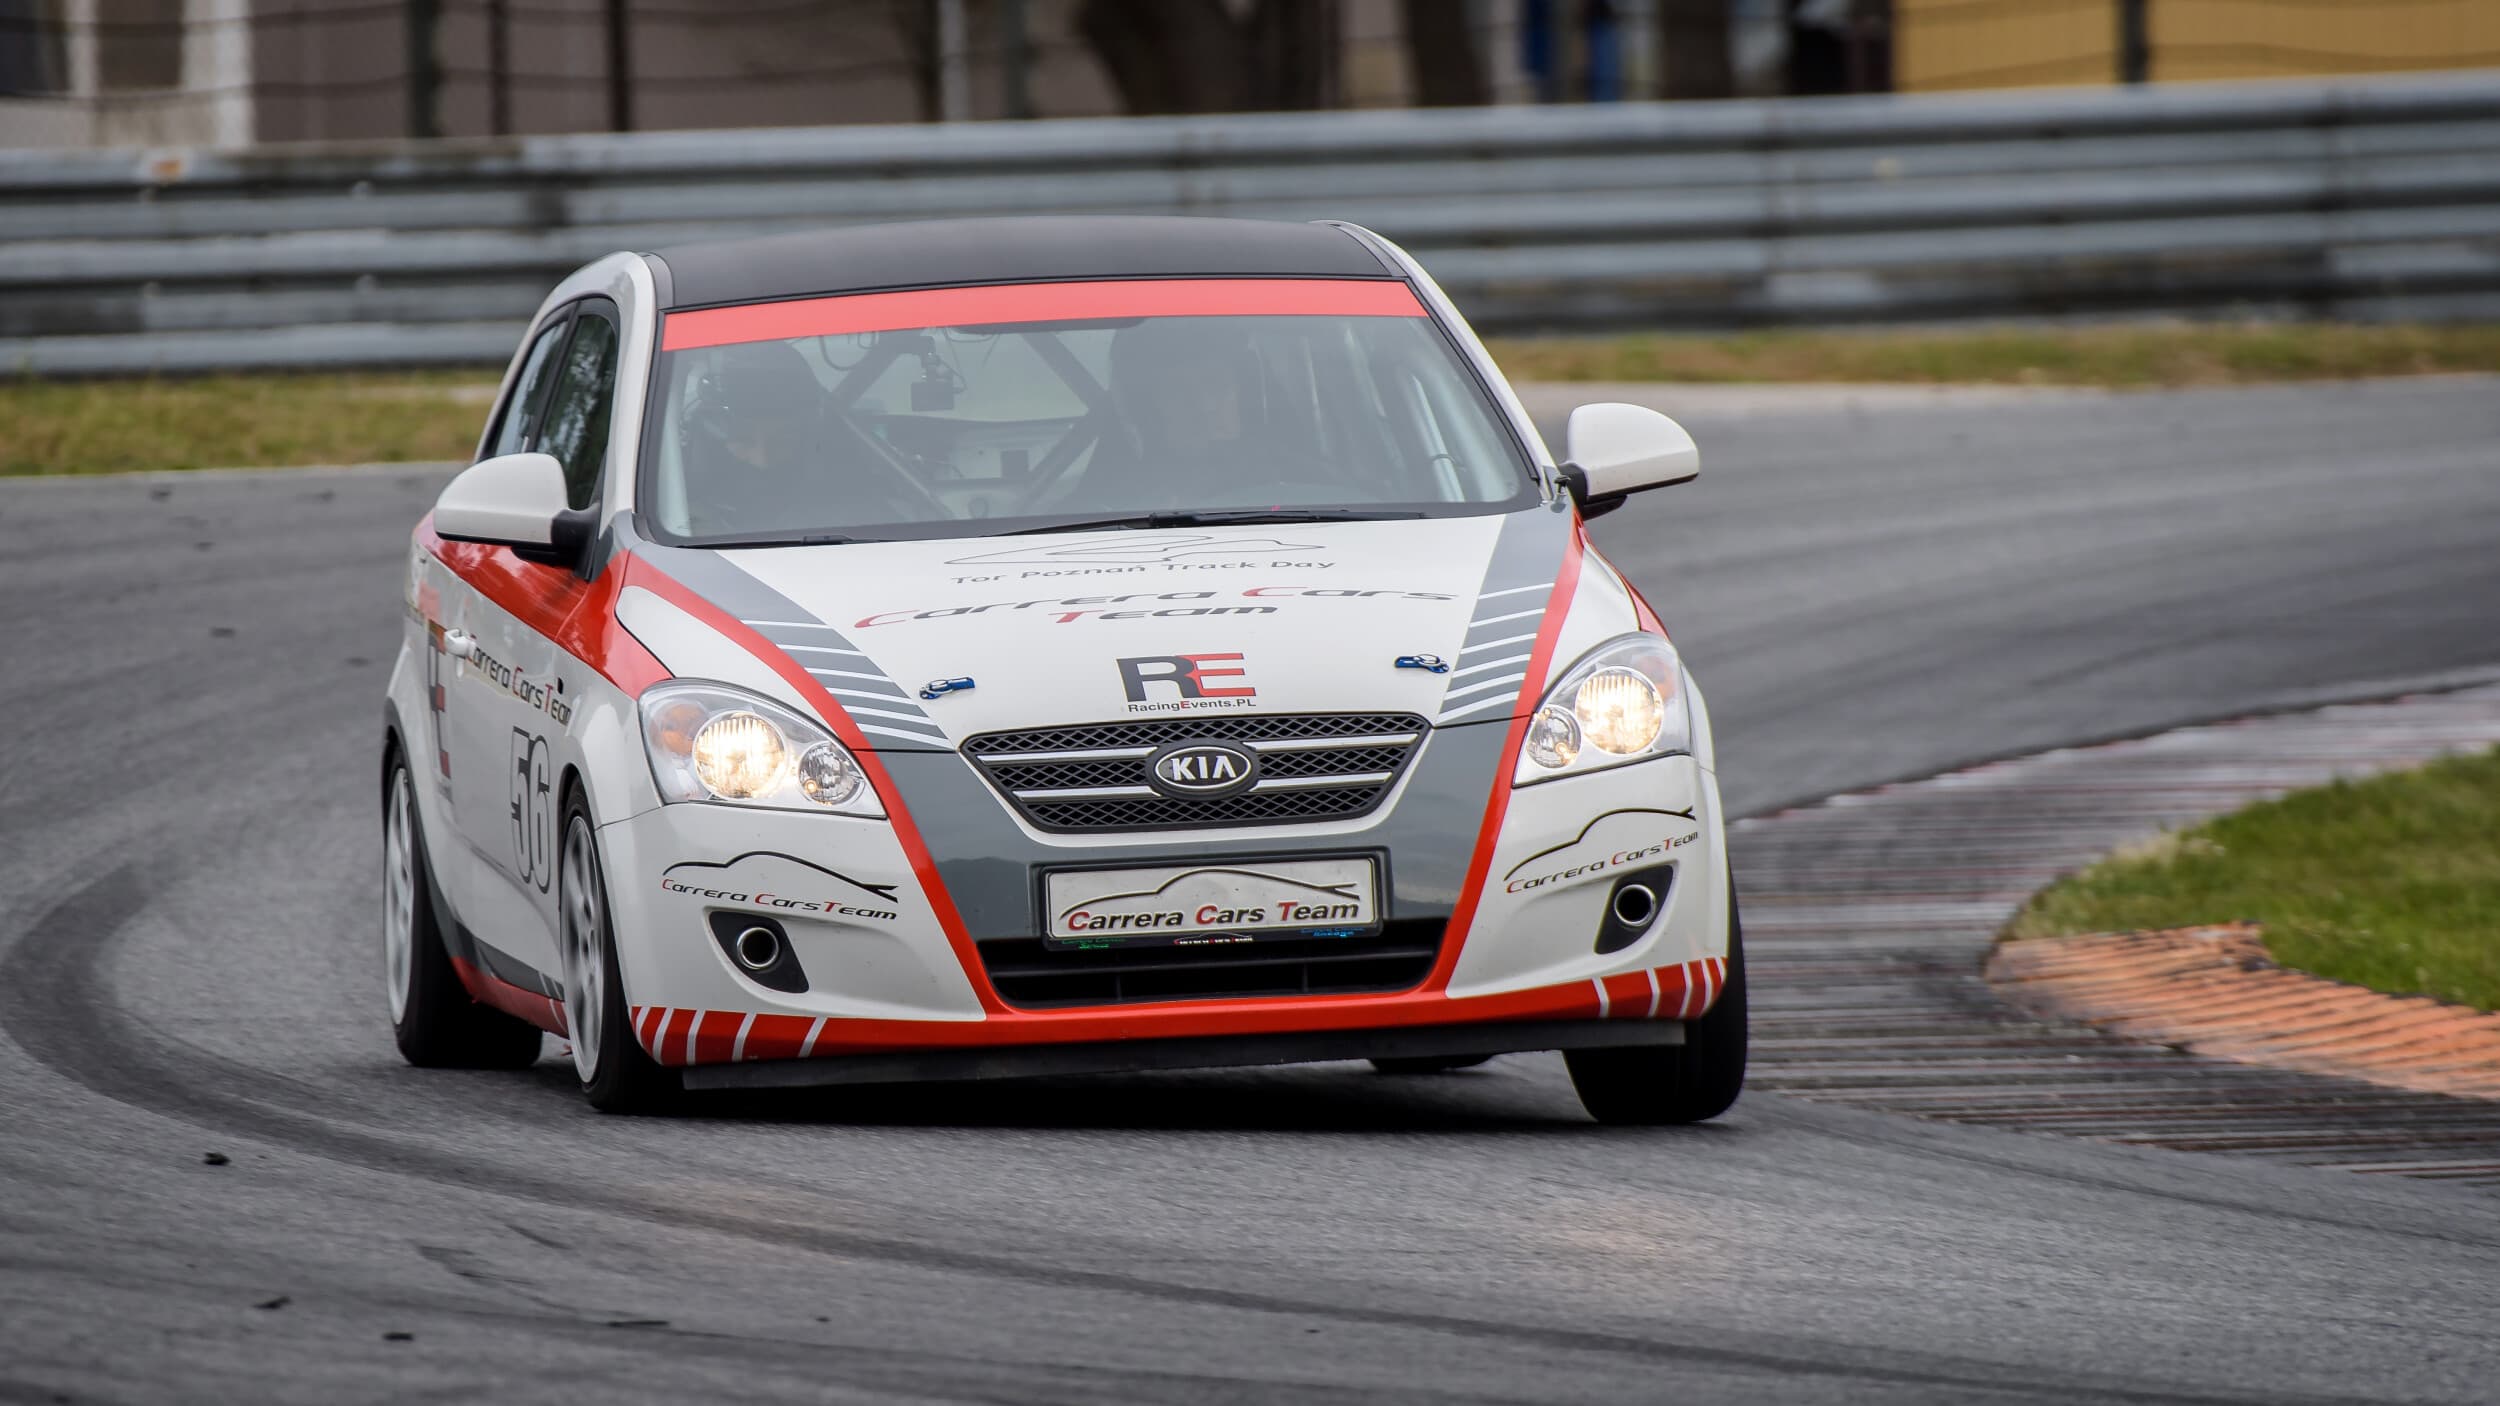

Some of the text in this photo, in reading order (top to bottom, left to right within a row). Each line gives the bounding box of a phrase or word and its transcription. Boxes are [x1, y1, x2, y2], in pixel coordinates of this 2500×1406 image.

[951, 560, 1336, 584] Tor Poznań Track Day
[854, 586, 1459, 629] Carrera Cars
[1048, 605, 1278, 624] Team
[1116, 652, 1257, 703] RE
[1127, 698, 1257, 713] RacingEvents.PL
[1169, 755, 1237, 783] KIA
[510, 726, 551, 895] 56
[661, 878, 749, 903] Carrera
[1505, 861, 1604, 894] Carrera
[1067, 900, 1360, 932] Carrera Cars Team
